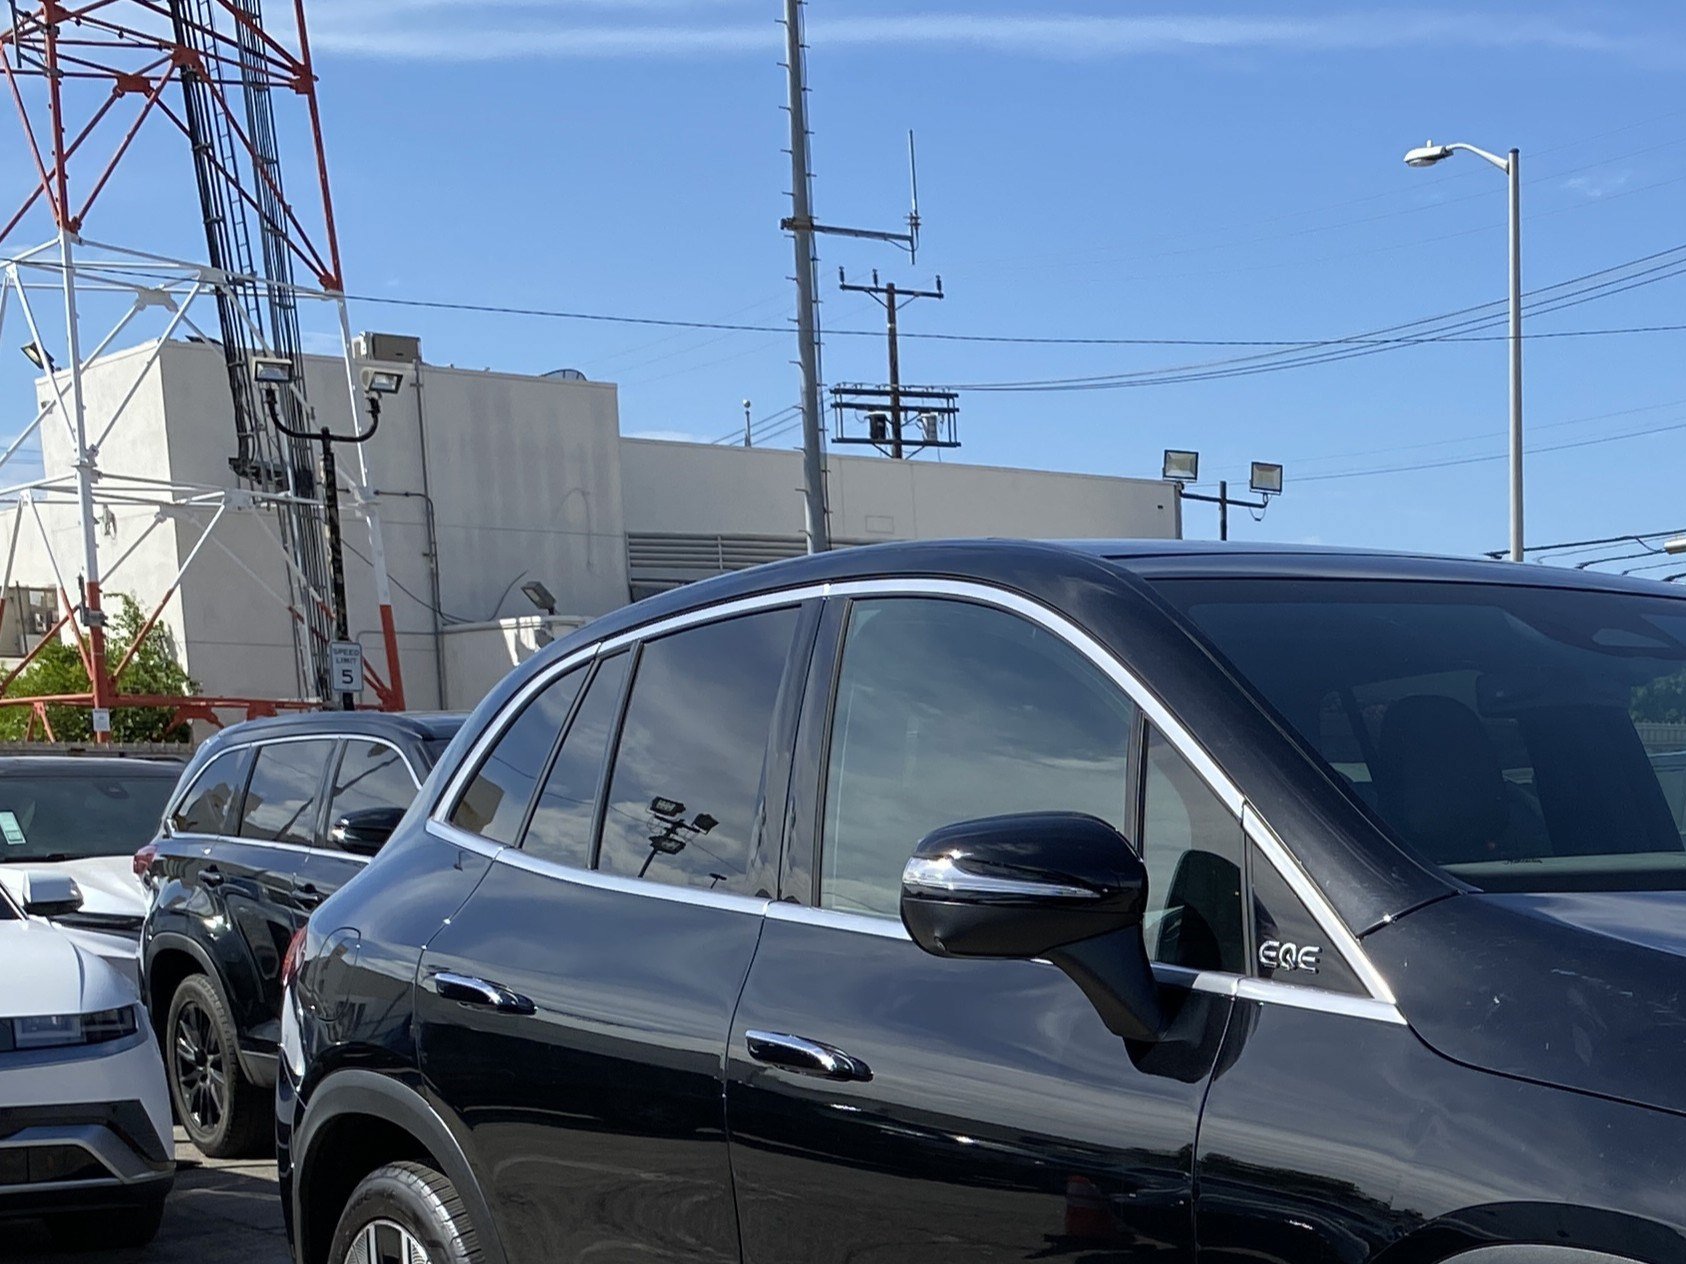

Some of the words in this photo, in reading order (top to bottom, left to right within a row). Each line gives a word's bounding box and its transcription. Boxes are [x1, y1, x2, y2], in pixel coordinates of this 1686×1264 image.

[333, 648, 360, 656] SPEED
[342, 669, 354, 685] 5
[1259, 940, 1320, 974] EQE
